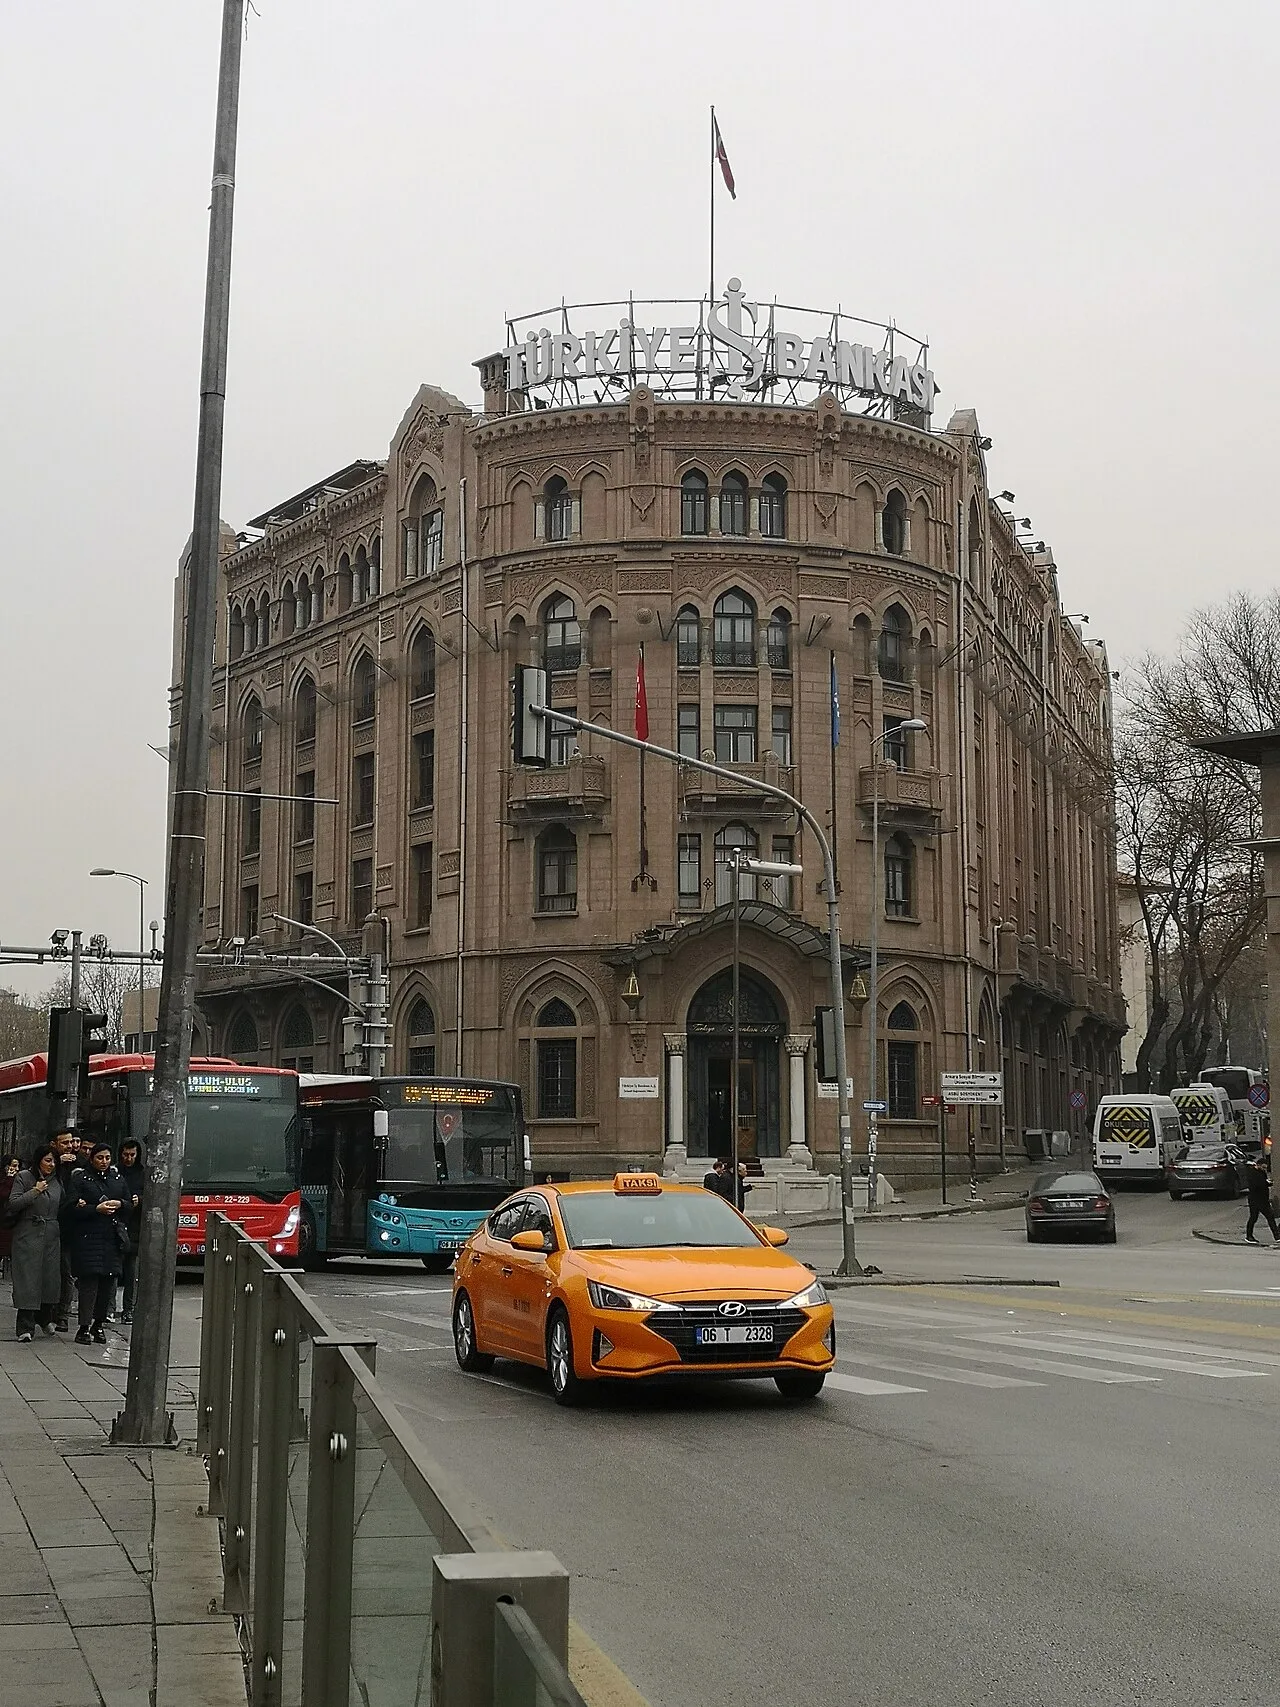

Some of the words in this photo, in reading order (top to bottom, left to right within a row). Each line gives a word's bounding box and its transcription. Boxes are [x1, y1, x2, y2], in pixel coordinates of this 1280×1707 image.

[502, 317, 695, 391] TÜRKİYE
[775, 331, 936, 412] BANKASI
[194, 1195, 209, 1203] EGO
[179, 1215, 198, 1224] EGO
[702, 1327, 717, 1342] 06
[723, 1327, 731, 1342] T
[745, 1326, 772, 1341] 2328
